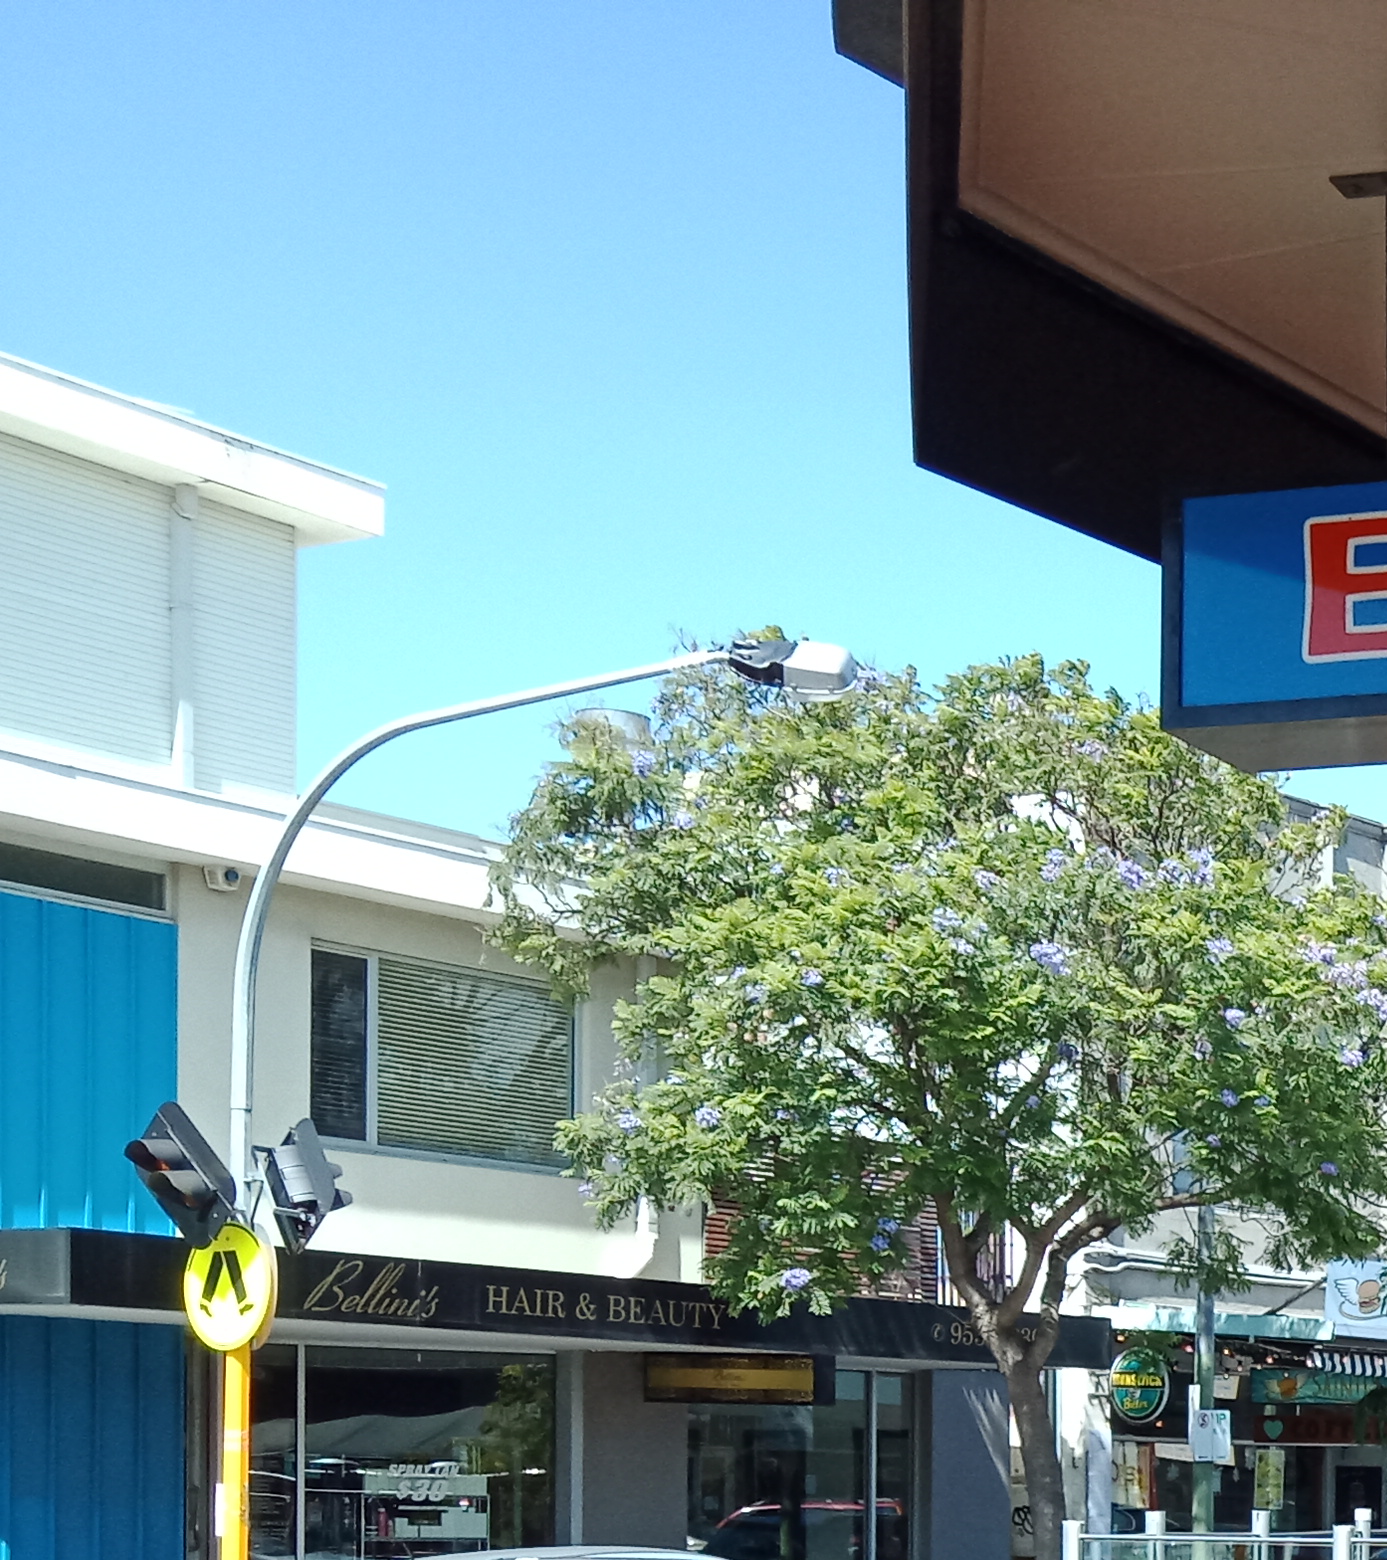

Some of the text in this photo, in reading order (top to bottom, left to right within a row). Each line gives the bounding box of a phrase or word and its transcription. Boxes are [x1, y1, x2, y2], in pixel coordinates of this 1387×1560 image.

[303, 1259, 439, 1319] Bellini's
[485, 1284, 726, 1330] HAIR & BEAUTY
[396, 1479, 449, 1502] $30
